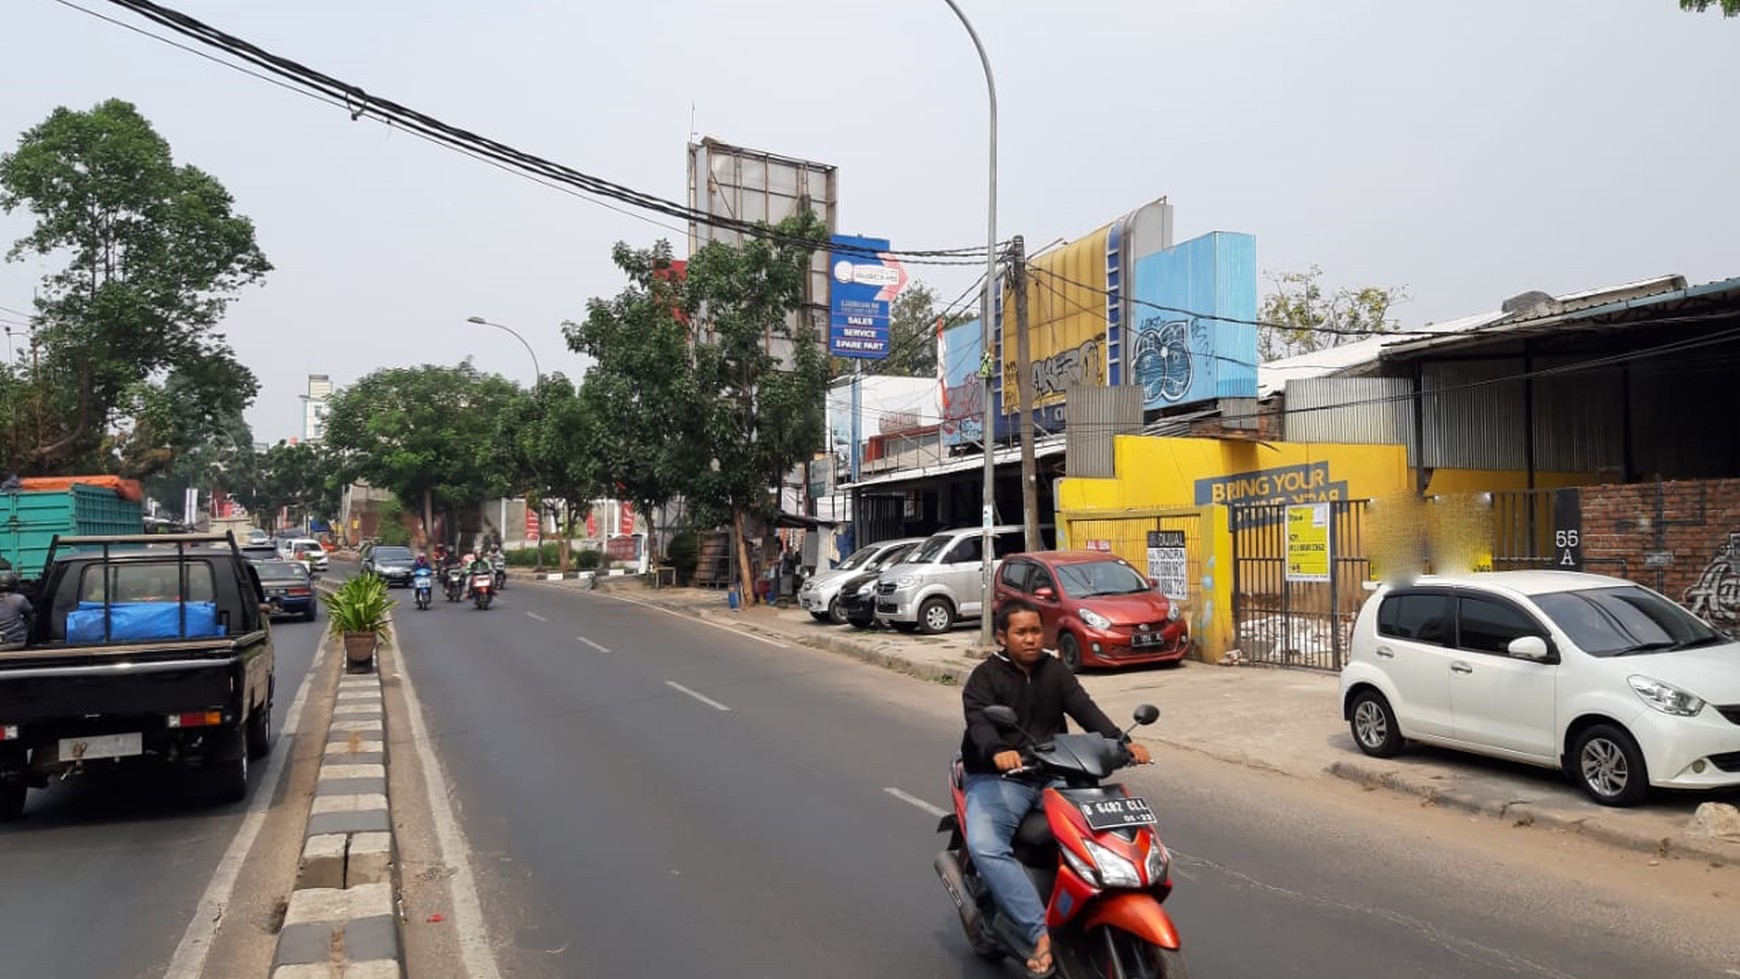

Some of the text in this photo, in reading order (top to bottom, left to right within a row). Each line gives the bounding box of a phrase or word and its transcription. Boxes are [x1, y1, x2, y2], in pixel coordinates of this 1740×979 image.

[848, 316, 873, 325] SALES
[843, 329, 876, 337] SERVICE
[836, 339, 884, 351] SPARE PART
[1212, 477, 1269, 503] BRING
[1272, 469, 1324, 492] YOUR
[1560, 548, 1576, 566] A
